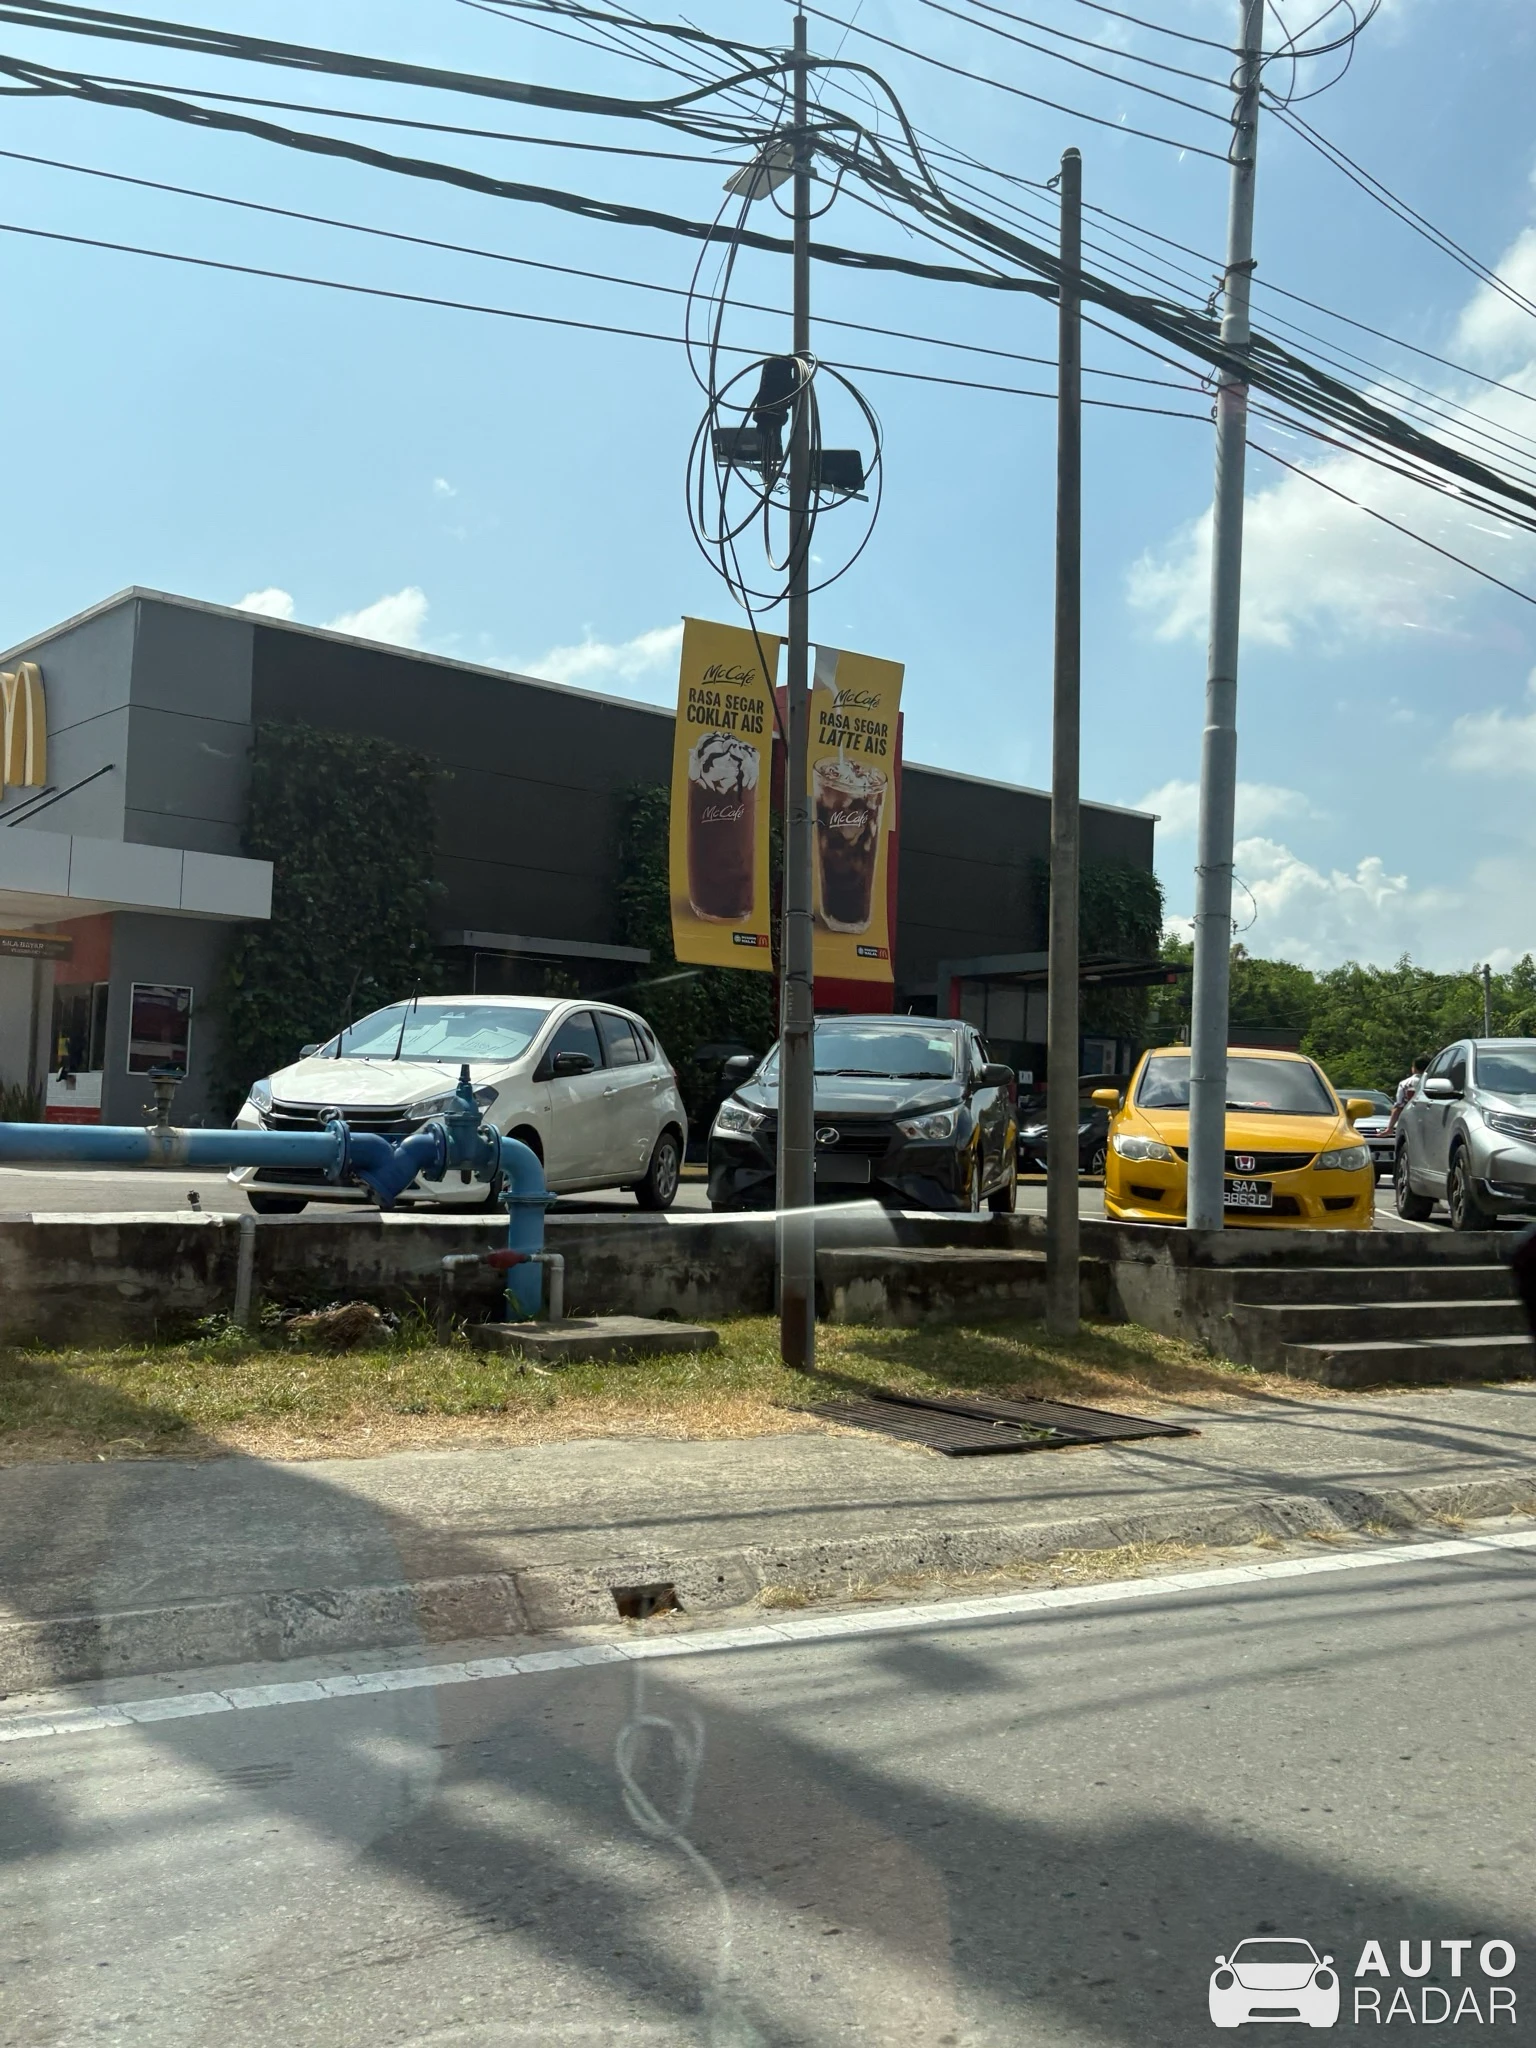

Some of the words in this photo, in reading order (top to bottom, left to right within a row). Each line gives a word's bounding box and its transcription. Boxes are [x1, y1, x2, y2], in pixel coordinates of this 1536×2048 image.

[702, 664, 756, 687] McCafé
[689, 688, 720, 707] RASA
[725, 694, 764, 715] SEGAR
[832, 688, 881, 711] McCafé
[687, 704, 738, 730] COKLAT
[741, 714, 764, 734] AIS
[820, 711, 850, 730] RASA
[854, 717, 888, 738] SEGAR
[819, 727, 862, 751] LATTE
[864, 735, 887, 756] AIS
[701, 803, 745, 824] McCafé
[829, 810, 869, 829] McCafé
[1232, 1181, 1257, 1193] SAA
